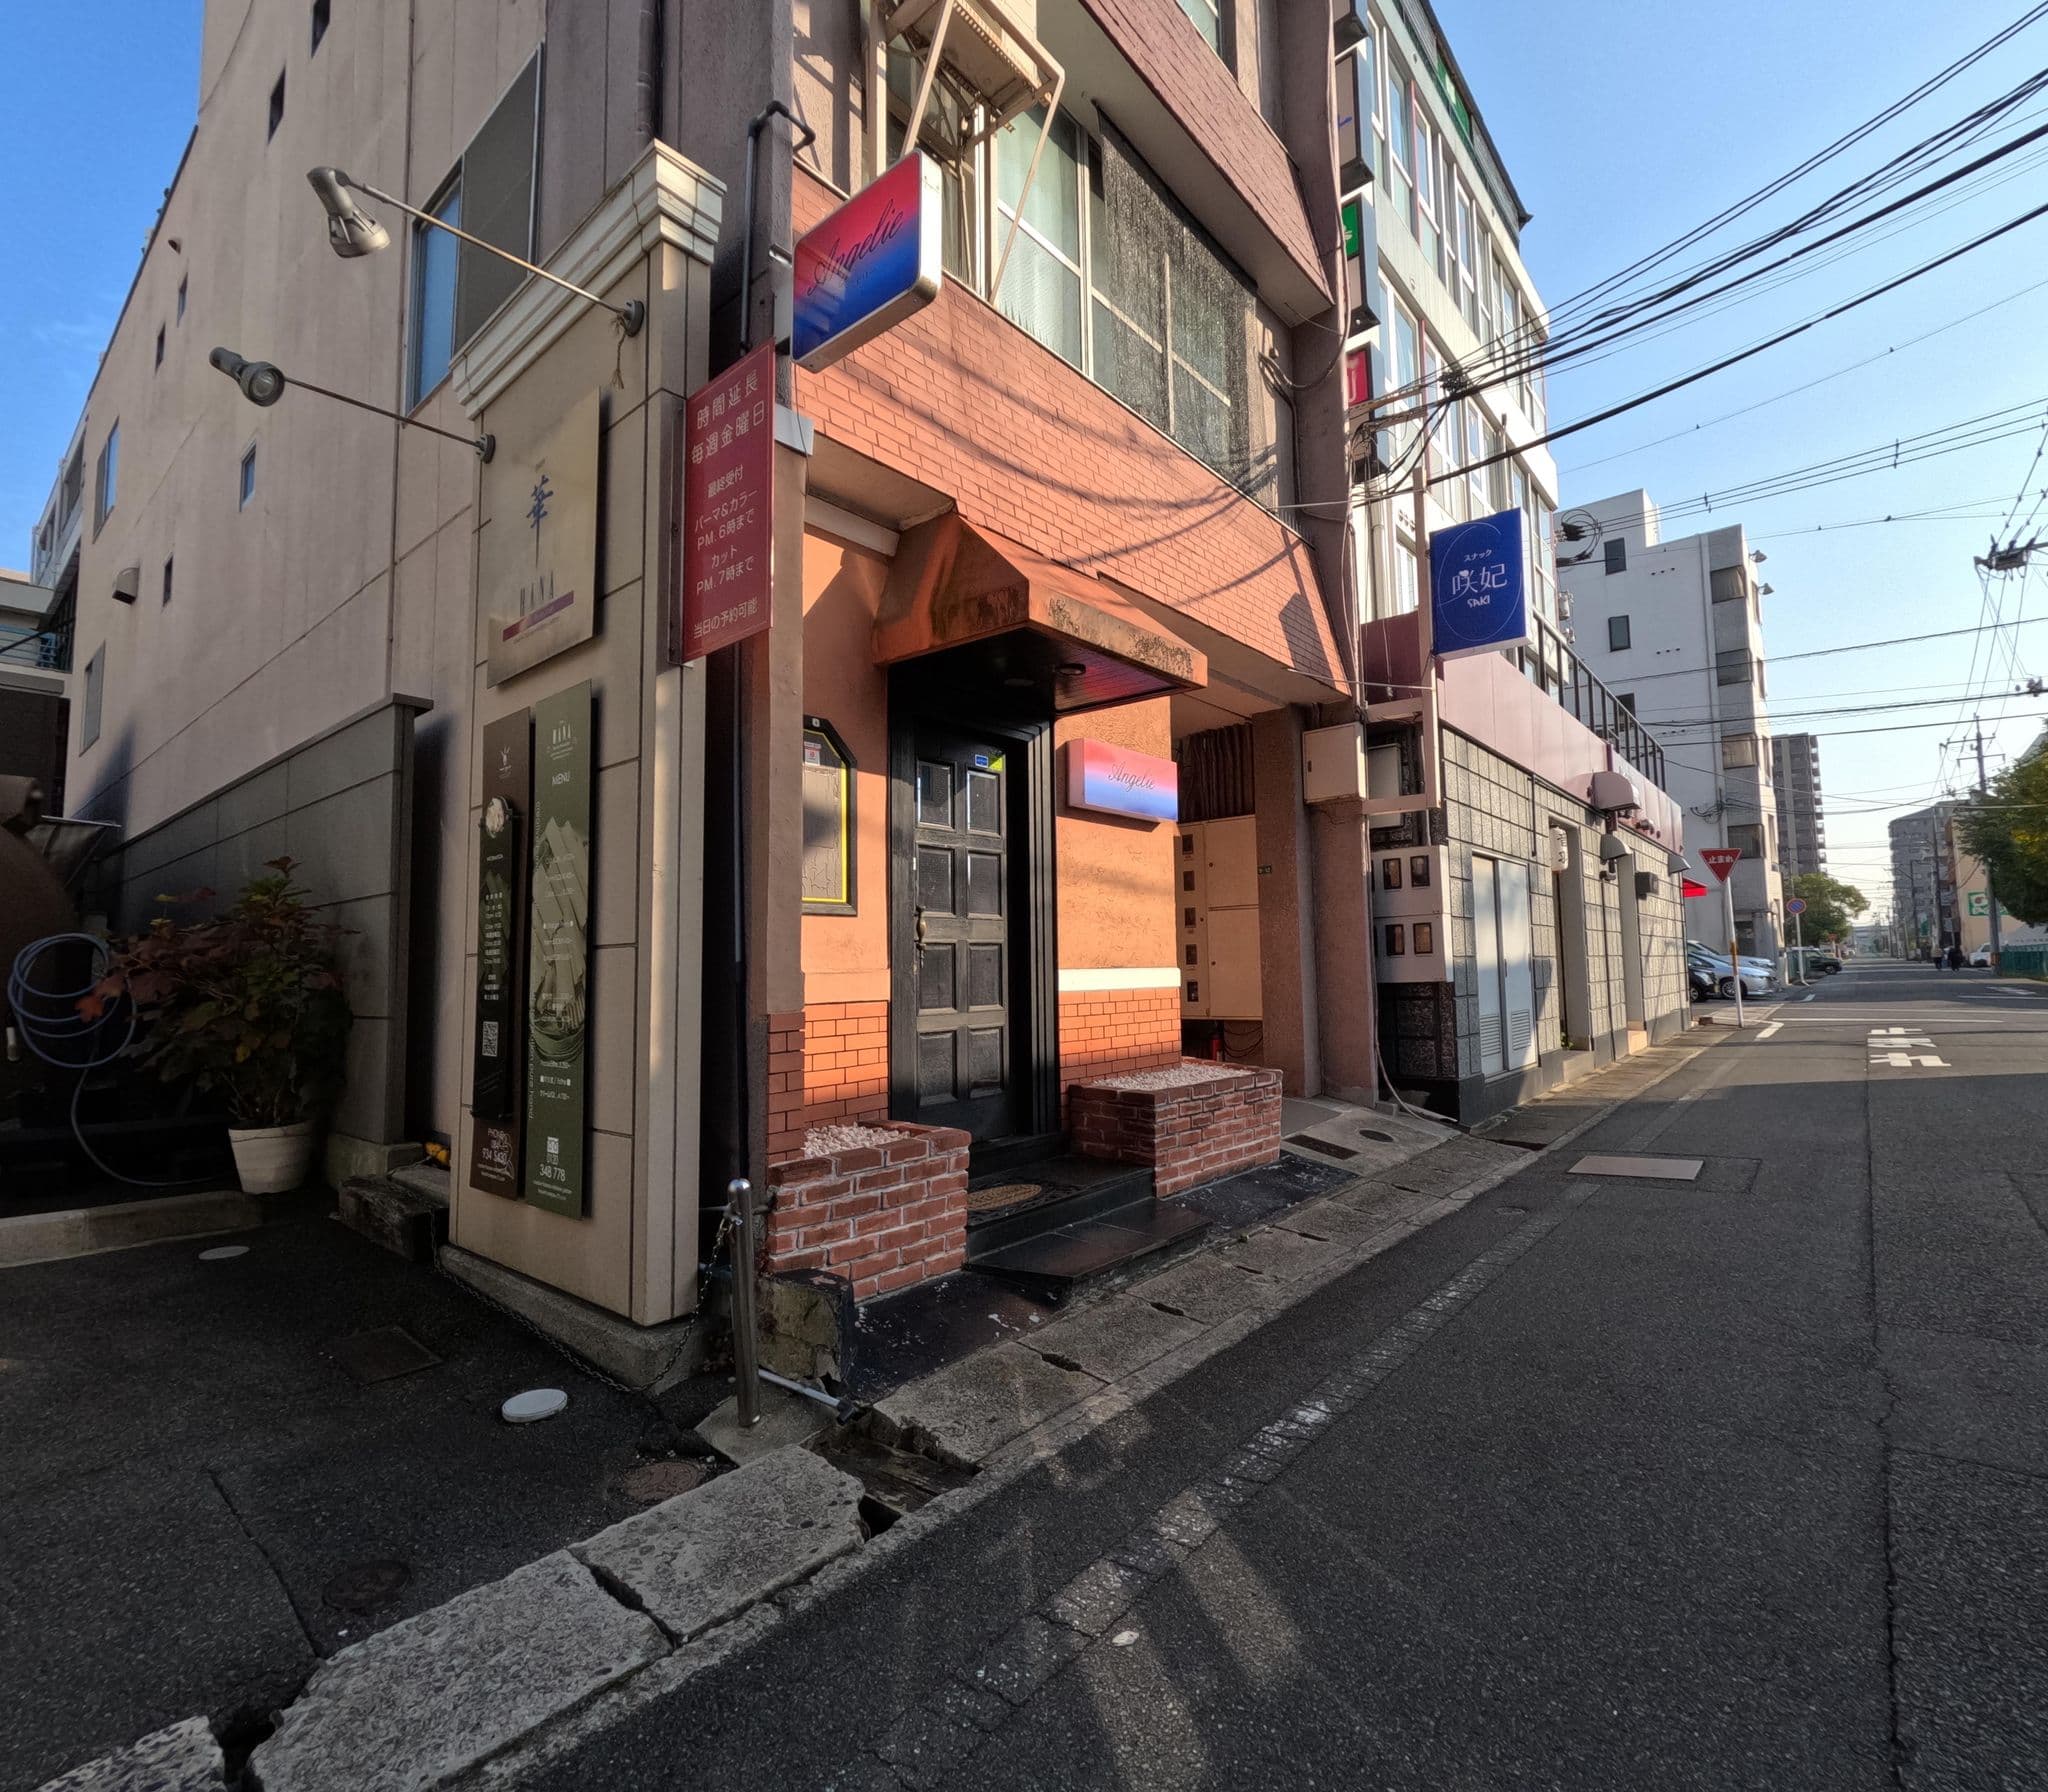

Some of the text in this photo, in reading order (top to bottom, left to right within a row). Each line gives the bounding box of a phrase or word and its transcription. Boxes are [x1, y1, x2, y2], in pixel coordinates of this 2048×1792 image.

[696, 368, 759, 430] 時間延長
[690, 399, 765, 466] 毎週金曜日
[707, 464, 744, 498] 最終受付
[711, 544, 738, 568] カット
[1464, 549, 1492, 563] スナック
[1452, 563, 1508, 597] 咲妃
[692, 597, 758, 639] 当日の予約可能
[1709, 855, 1734, 864] 止まれ
